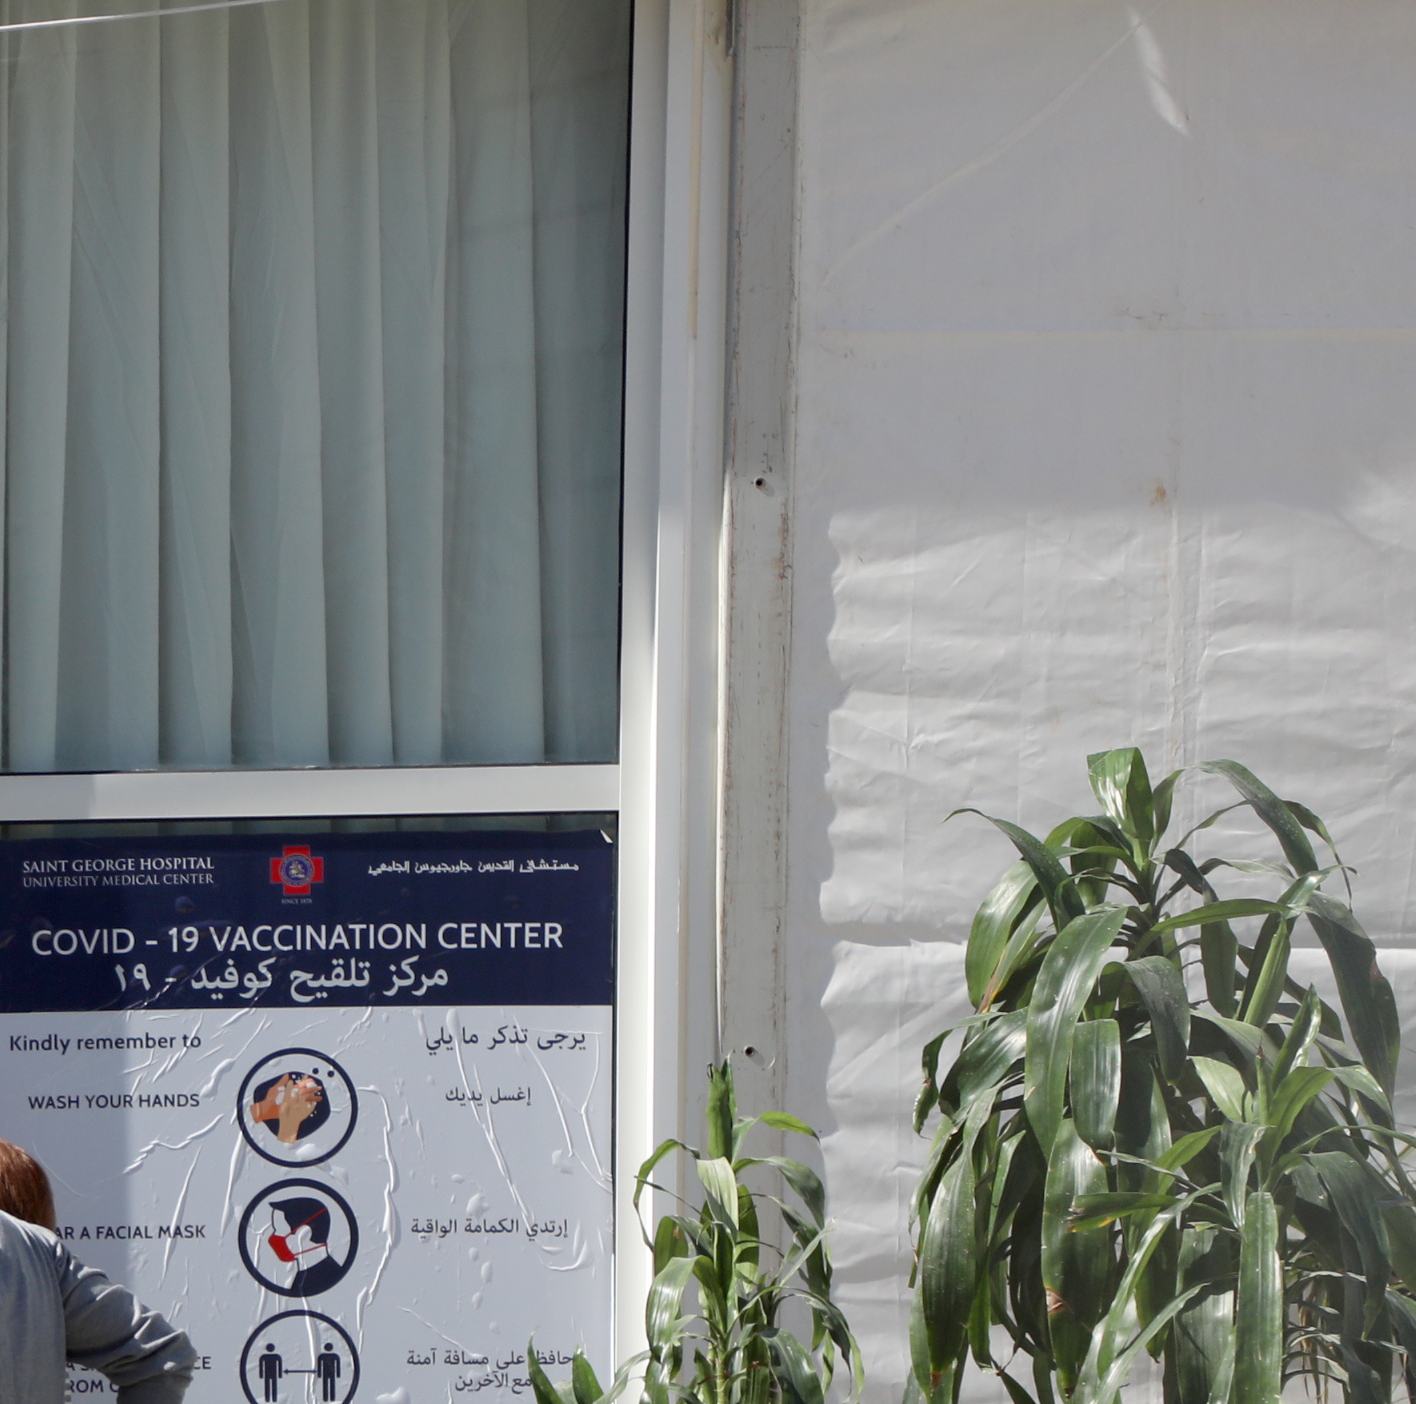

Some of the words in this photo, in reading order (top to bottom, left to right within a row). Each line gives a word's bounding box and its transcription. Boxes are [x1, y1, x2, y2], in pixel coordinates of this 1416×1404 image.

[22, 859, 69, 874] SAINT
[72, 858, 136, 872] GEORGE
[140, 856, 215, 870] HOSPITAL
[368, 860, 410, 876] الجامعي
[414, 860, 473, 874] جاورجيوس
[478, 859, 515, 873] القديس
[519, 858, 580, 873] مستشفى
[23, 875, 99, 888] UNIVERSITY
[102, 874, 161, 887] MEDICAL
[163, 873, 215, 885] CENTER
[32, 929, 135, 955] COVID
[168, 927, 199, 952] 19
[210, 924, 427, 952] VACCINATION
[438, 922, 564, 949] CENTER
[115, 963, 152, 992] ١٩
[191, 957, 277, 1000] كوفيد
[289, 957, 371, 1003] تلقيح
[382, 955, 449, 996] مركز
[10, 1033, 70, 1055] Kindly
[77, 1032, 177, 1050] remember
[182, 1034, 201, 1049] to
[426, 1027, 454, 1055] يلي
[462, 1026, 479, 1044] ما
[487, 1025, 529, 1050] تذكر
[537, 1032, 586, 1051] يرجى
[28, 1095, 80, 1109] WASH
[85, 1094, 133, 1109] YOUR
[139, 1093, 200, 1108] HANDS
[445, 1087, 483, 1106] يديك
[489, 1087, 532, 1106] إغسل
[79, 1226, 91, 1240] A
[96, 1226, 153, 1240] FACIAL
[158, 1225, 207, 1239] MASK
[410, 1218, 458, 1239] الواقية
[464, 1218, 520, 1234] الكمامة
[525, 1218, 568, 1242] إرتدي
[406, 1348, 437, 1366] آمنة
[443, 1351, 489, 1366] مسافة
[496, 1350, 526, 1369] على
[69, 1380, 104, 1393] ROM
[455, 1371, 509, 1391] الآخرين
[511, 1378, 532, 1394] مع
